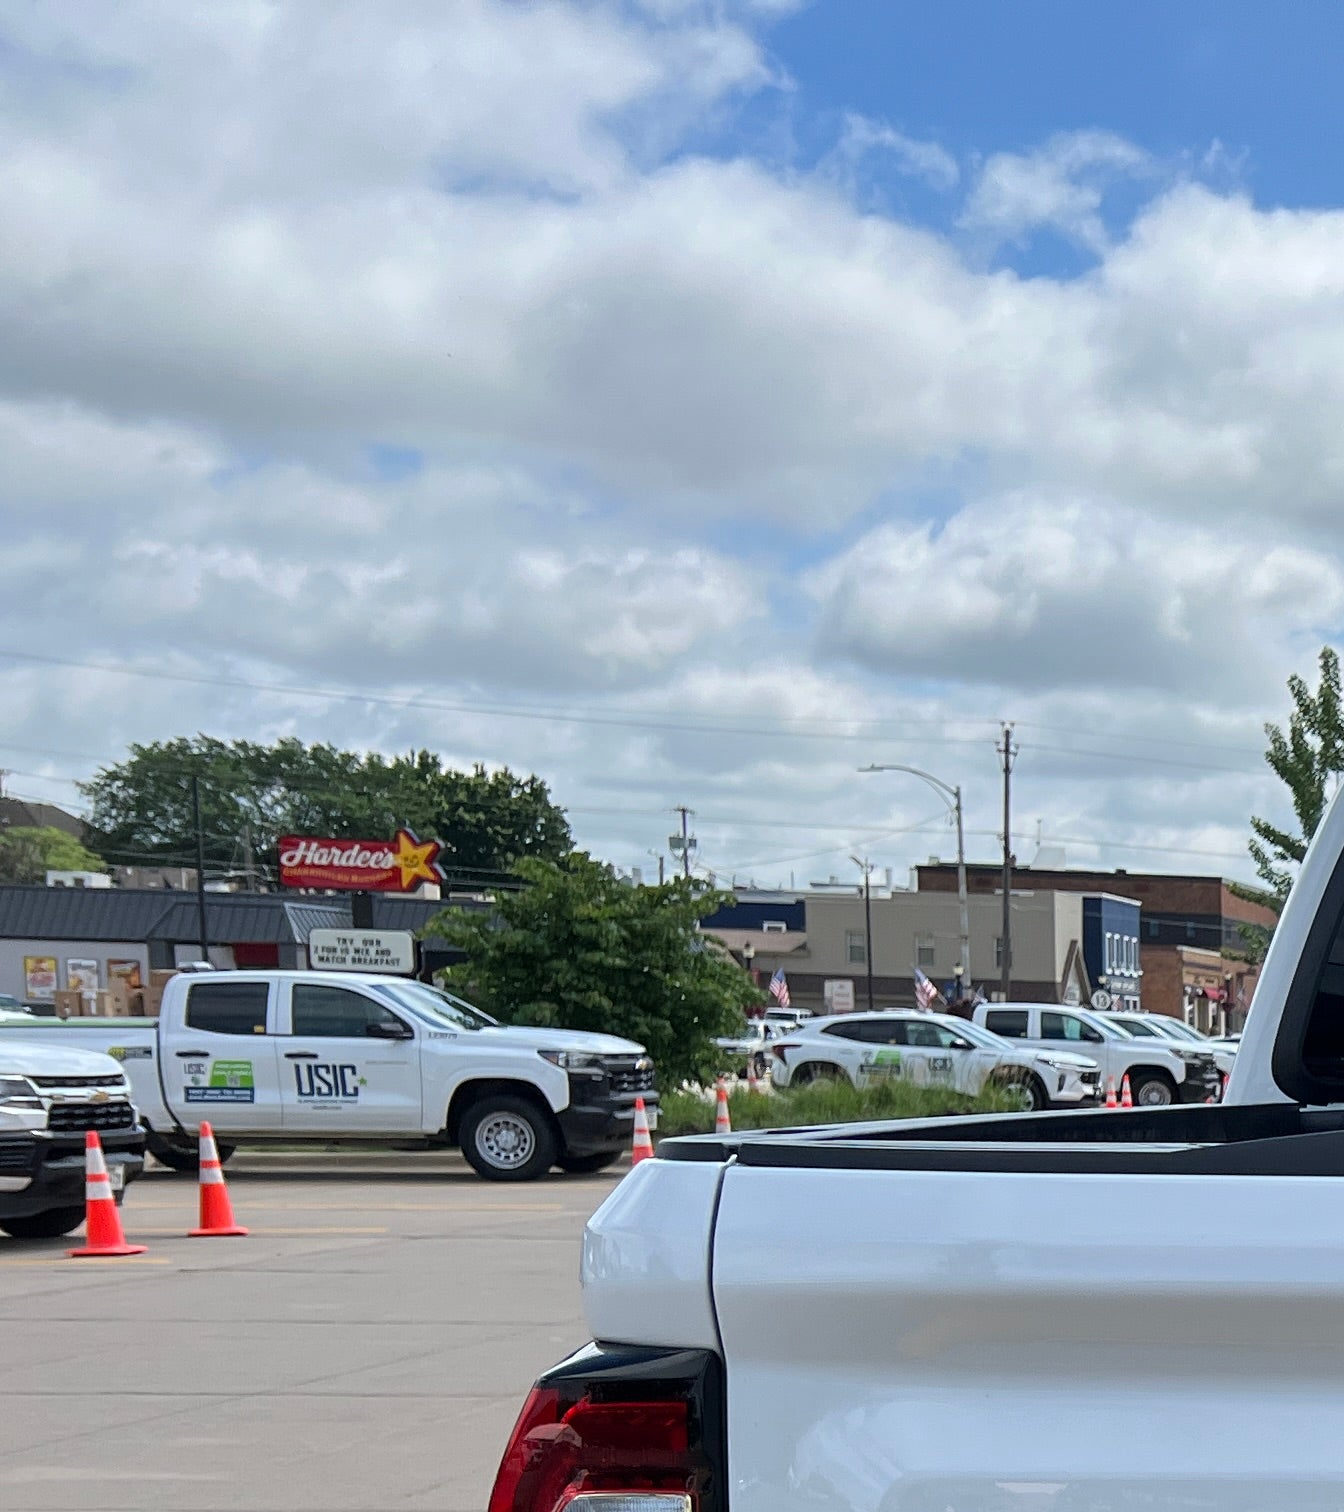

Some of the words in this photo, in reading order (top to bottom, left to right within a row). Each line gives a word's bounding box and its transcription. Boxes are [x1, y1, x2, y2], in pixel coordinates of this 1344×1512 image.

[280, 841, 395, 868] Hardee's
[318, 955, 347, 964] MATCH
[351, 957, 401, 966] BREAKFAST
[294, 1064, 359, 1097] USIC
